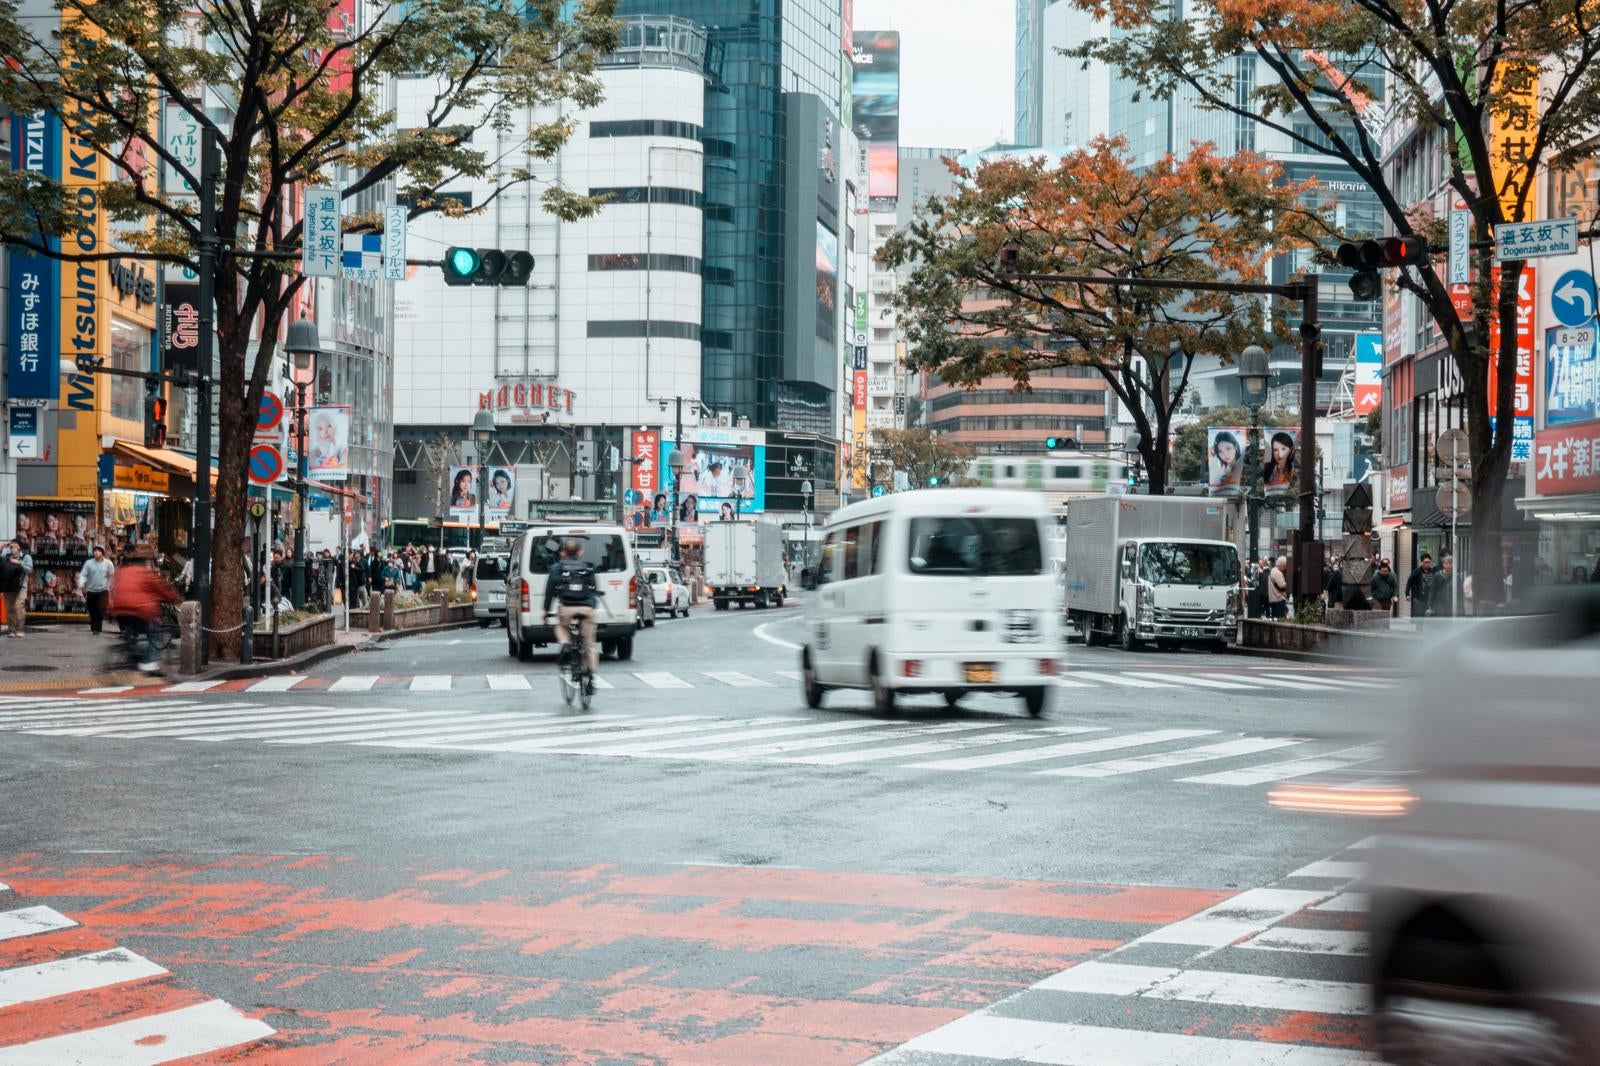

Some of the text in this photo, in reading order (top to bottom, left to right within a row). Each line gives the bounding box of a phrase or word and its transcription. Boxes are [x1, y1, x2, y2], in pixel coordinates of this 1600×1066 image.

[185, 124, 197, 167] フルーツ
[1328, 180, 1367, 192] Hikarie
[308, 203, 318, 261] Dogenzaka shita
[319, 196, 335, 270] 道玄坂下
[389, 208, 401, 278] スクランブル式
[1454, 213, 1465, 281] スクランブル式
[1502, 223, 1570, 246] 道玄坂下
[1503, 241, 1570, 257] Dogenzaka shita
[20, 273, 40, 372] みずほ銀行
[172, 303, 199, 349] HUB
[1454, 300, 1468, 310] 3F
[1548, 343, 1595, 411] 24時間
[479, 383, 576, 416] MAGNET
[855, 432, 864, 466] プロミス
